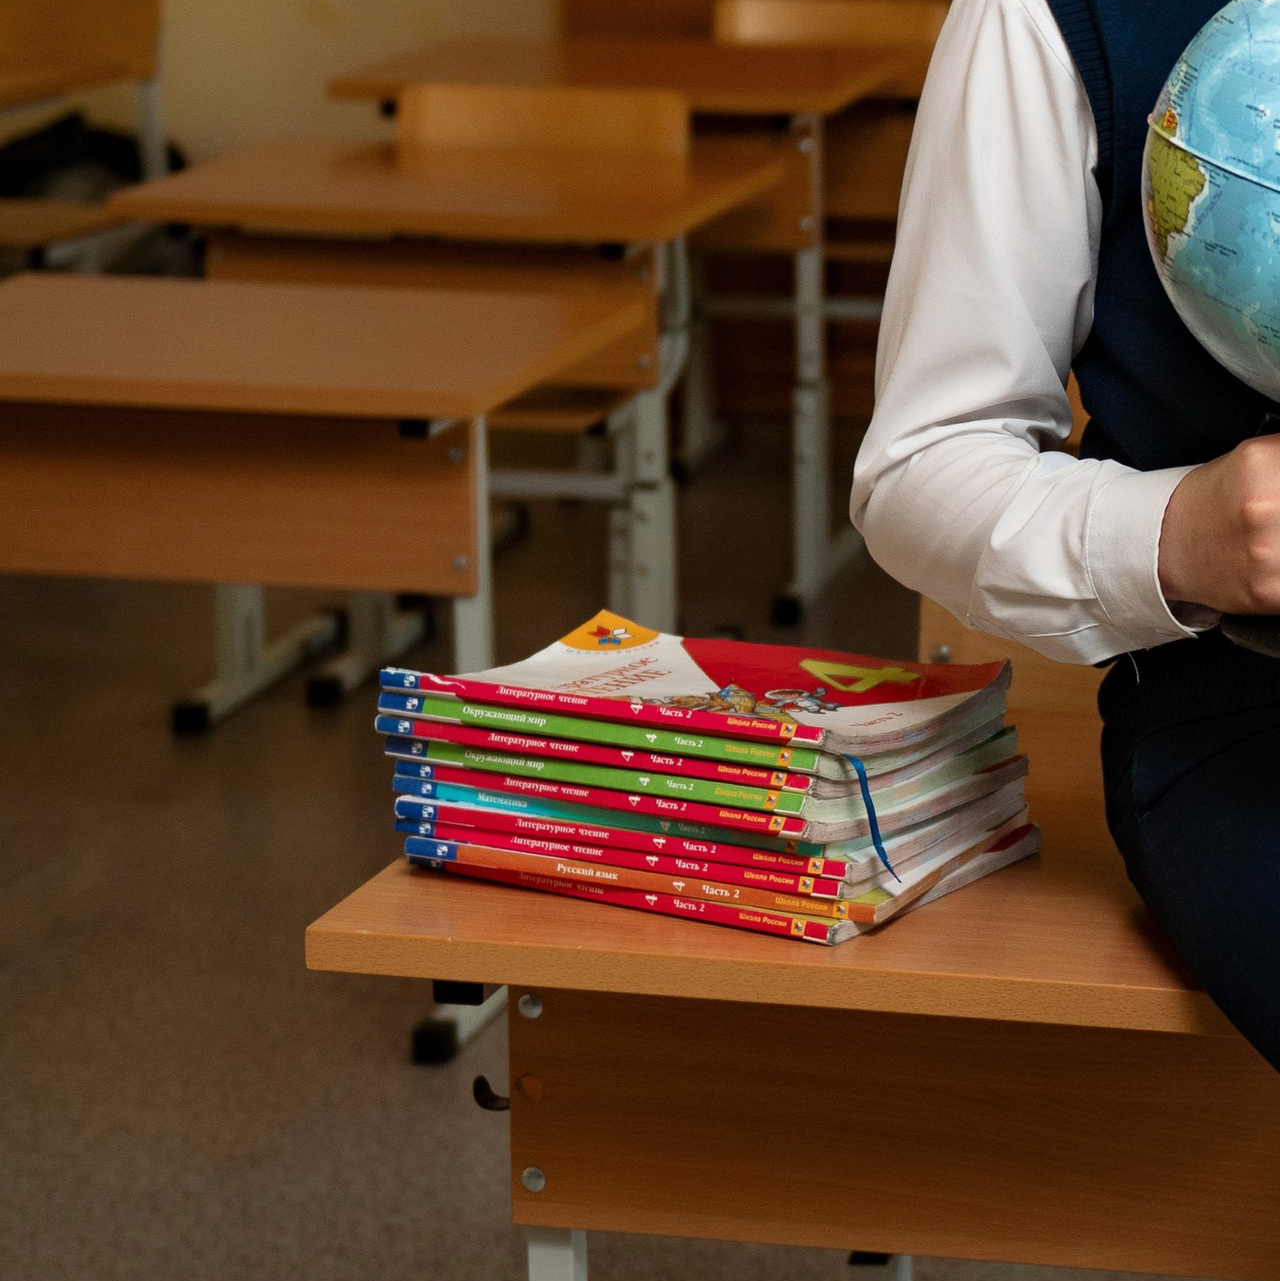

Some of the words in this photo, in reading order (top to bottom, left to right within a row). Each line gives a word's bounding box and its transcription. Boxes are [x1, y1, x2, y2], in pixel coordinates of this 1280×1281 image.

[799, 658, 922, 694] 4
[496, 686, 556, 701] Литературное
[559, 695, 588, 706] чтение
[630, 704, 643, 714] 4
[659, 706, 684, 718] Часть
[686, 710, 692, 718] 2
[462, 706, 526, 722] Окружающий
[527, 714, 547, 727] мир
[727, 717, 750, 728] Школа
[752, 721, 778, 730] России
[488, 733, 546, 750] Литературное
[549, 742, 580, 752] чтение
[646, 733, 658, 744] 4
[674, 736, 697, 747] Часть
[697, 740, 704, 748] 2
[621, 751, 634, 762] 4
[725, 744, 748, 754] Школа
[749, 748, 776, 758] России
[465, 750, 526, 766] Окружающий
[526, 760, 545, 771] мир
[650, 754, 674, 766] Часть
[676, 758, 684, 766] 2
[718, 765, 740, 775] Школа
[742, 768, 768, 778] России
[503, 778, 558, 794] Литературное
[561, 786, 590, 798] чтение
[639, 776, 650, 786] 4
[666, 779, 688, 790] Часть
[688, 782, 694, 792] 2
[478, 792, 528, 808] Математика
[628, 795, 641, 806] 4
[714, 787, 737, 798] Школа
[738, 790, 764, 802] России
[656, 798, 679, 810] Часть
[680, 802, 688, 811] 2
[719, 810, 741, 820] Школа
[742, 813, 767, 824] России
[515, 818, 576, 834] Литературное
[578, 827, 610, 840] чтение
[510, 836, 570, 852] Литературное
[572, 846, 604, 857] чтение
[653, 837, 666, 850] 4
[682, 841, 708, 853] Часть
[710, 845, 717, 854] 2
[646, 855, 659, 867] 4
[675, 859, 700, 870] Часть
[702, 863, 708, 872] 2
[752, 852, 777, 863] Школа
[778, 856, 804, 867] России
[556, 862, 594, 878] Русский
[596, 870, 619, 880] язык
[744, 871, 768, 881] Школа
[769, 875, 795, 886] России
[672, 880, 686, 892] 4
[702, 884, 730, 897] Часть
[733, 889, 740, 898] 2
[645, 894, 658, 906] 4
[673, 898, 697, 911] Часть
[698, 904, 706, 912] 2
[775, 896, 800, 908] Школа
[800, 900, 828, 912] России
[738, 912, 762, 922] Школа
[762, 916, 787, 927] России
